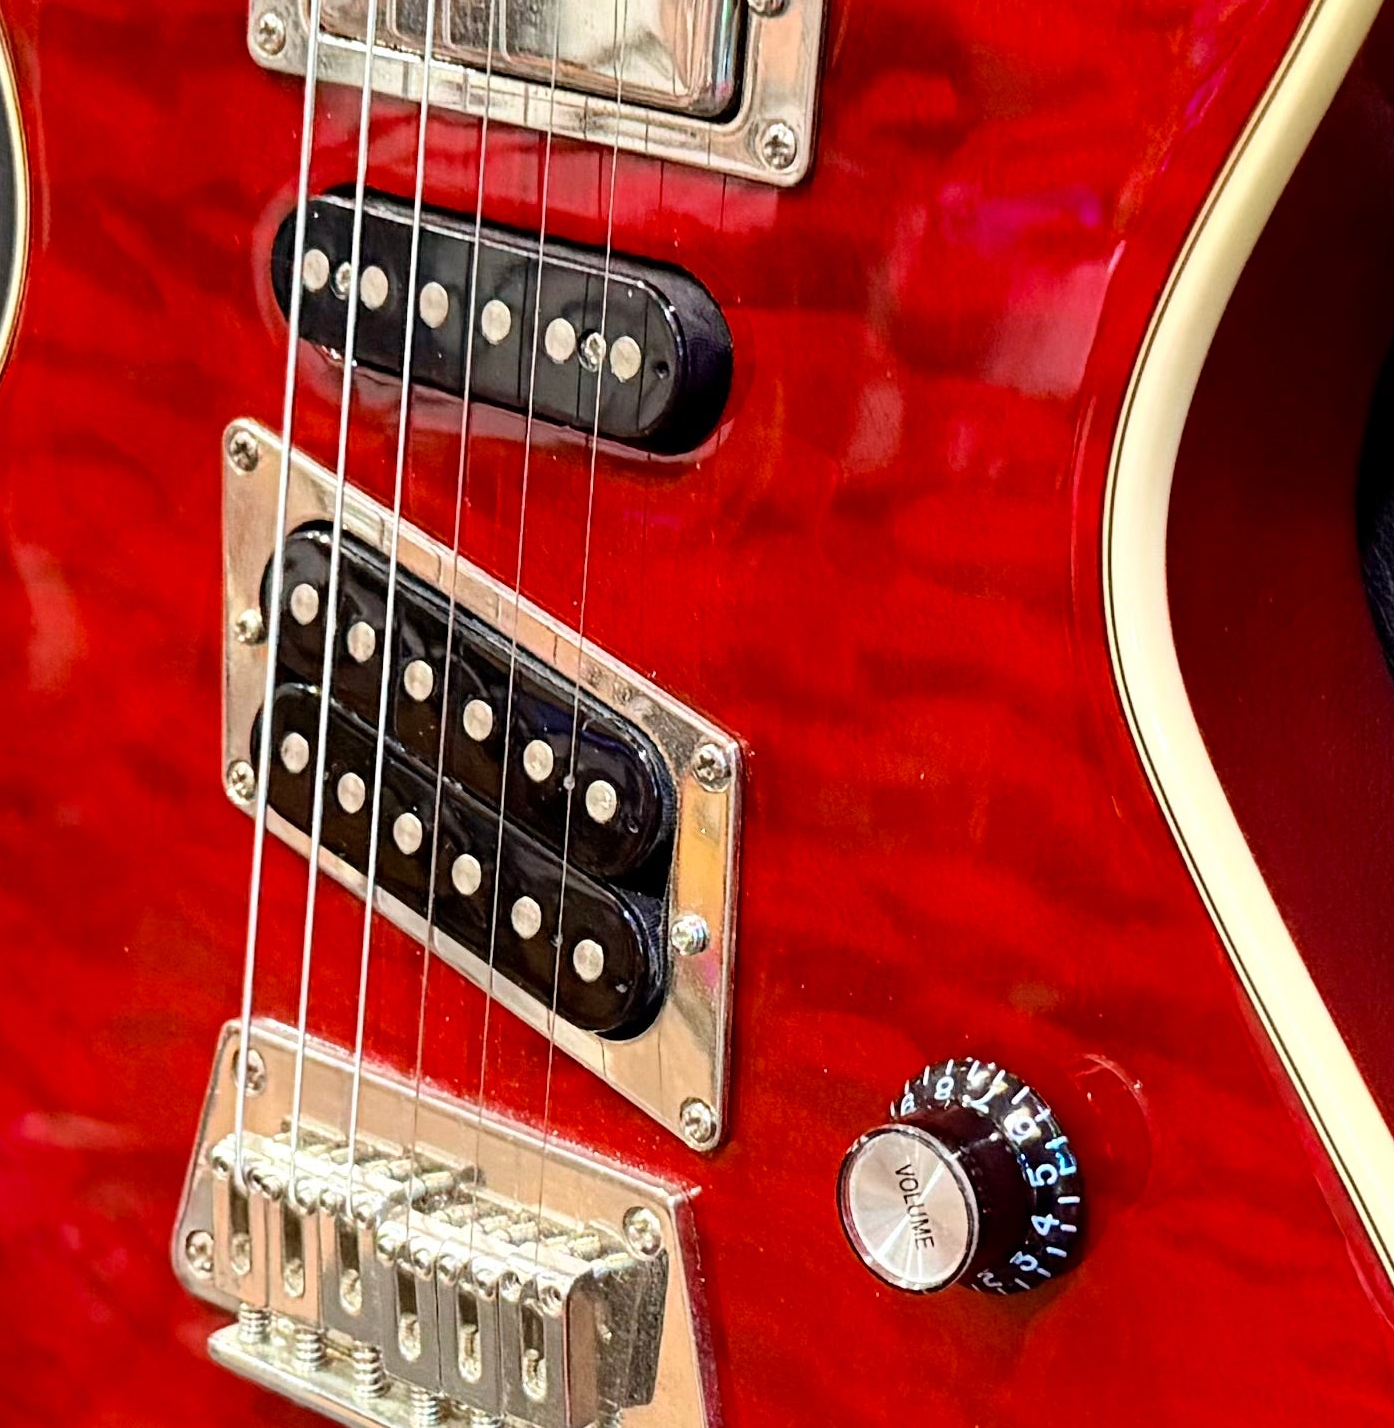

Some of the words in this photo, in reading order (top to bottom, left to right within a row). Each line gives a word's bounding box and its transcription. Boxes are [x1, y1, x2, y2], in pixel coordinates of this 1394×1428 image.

[1026, 1163, 1060, 1189] 5
[894, 1163, 935, 1251] VOLUME
[1031, 1213, 1060, 1238] 4
